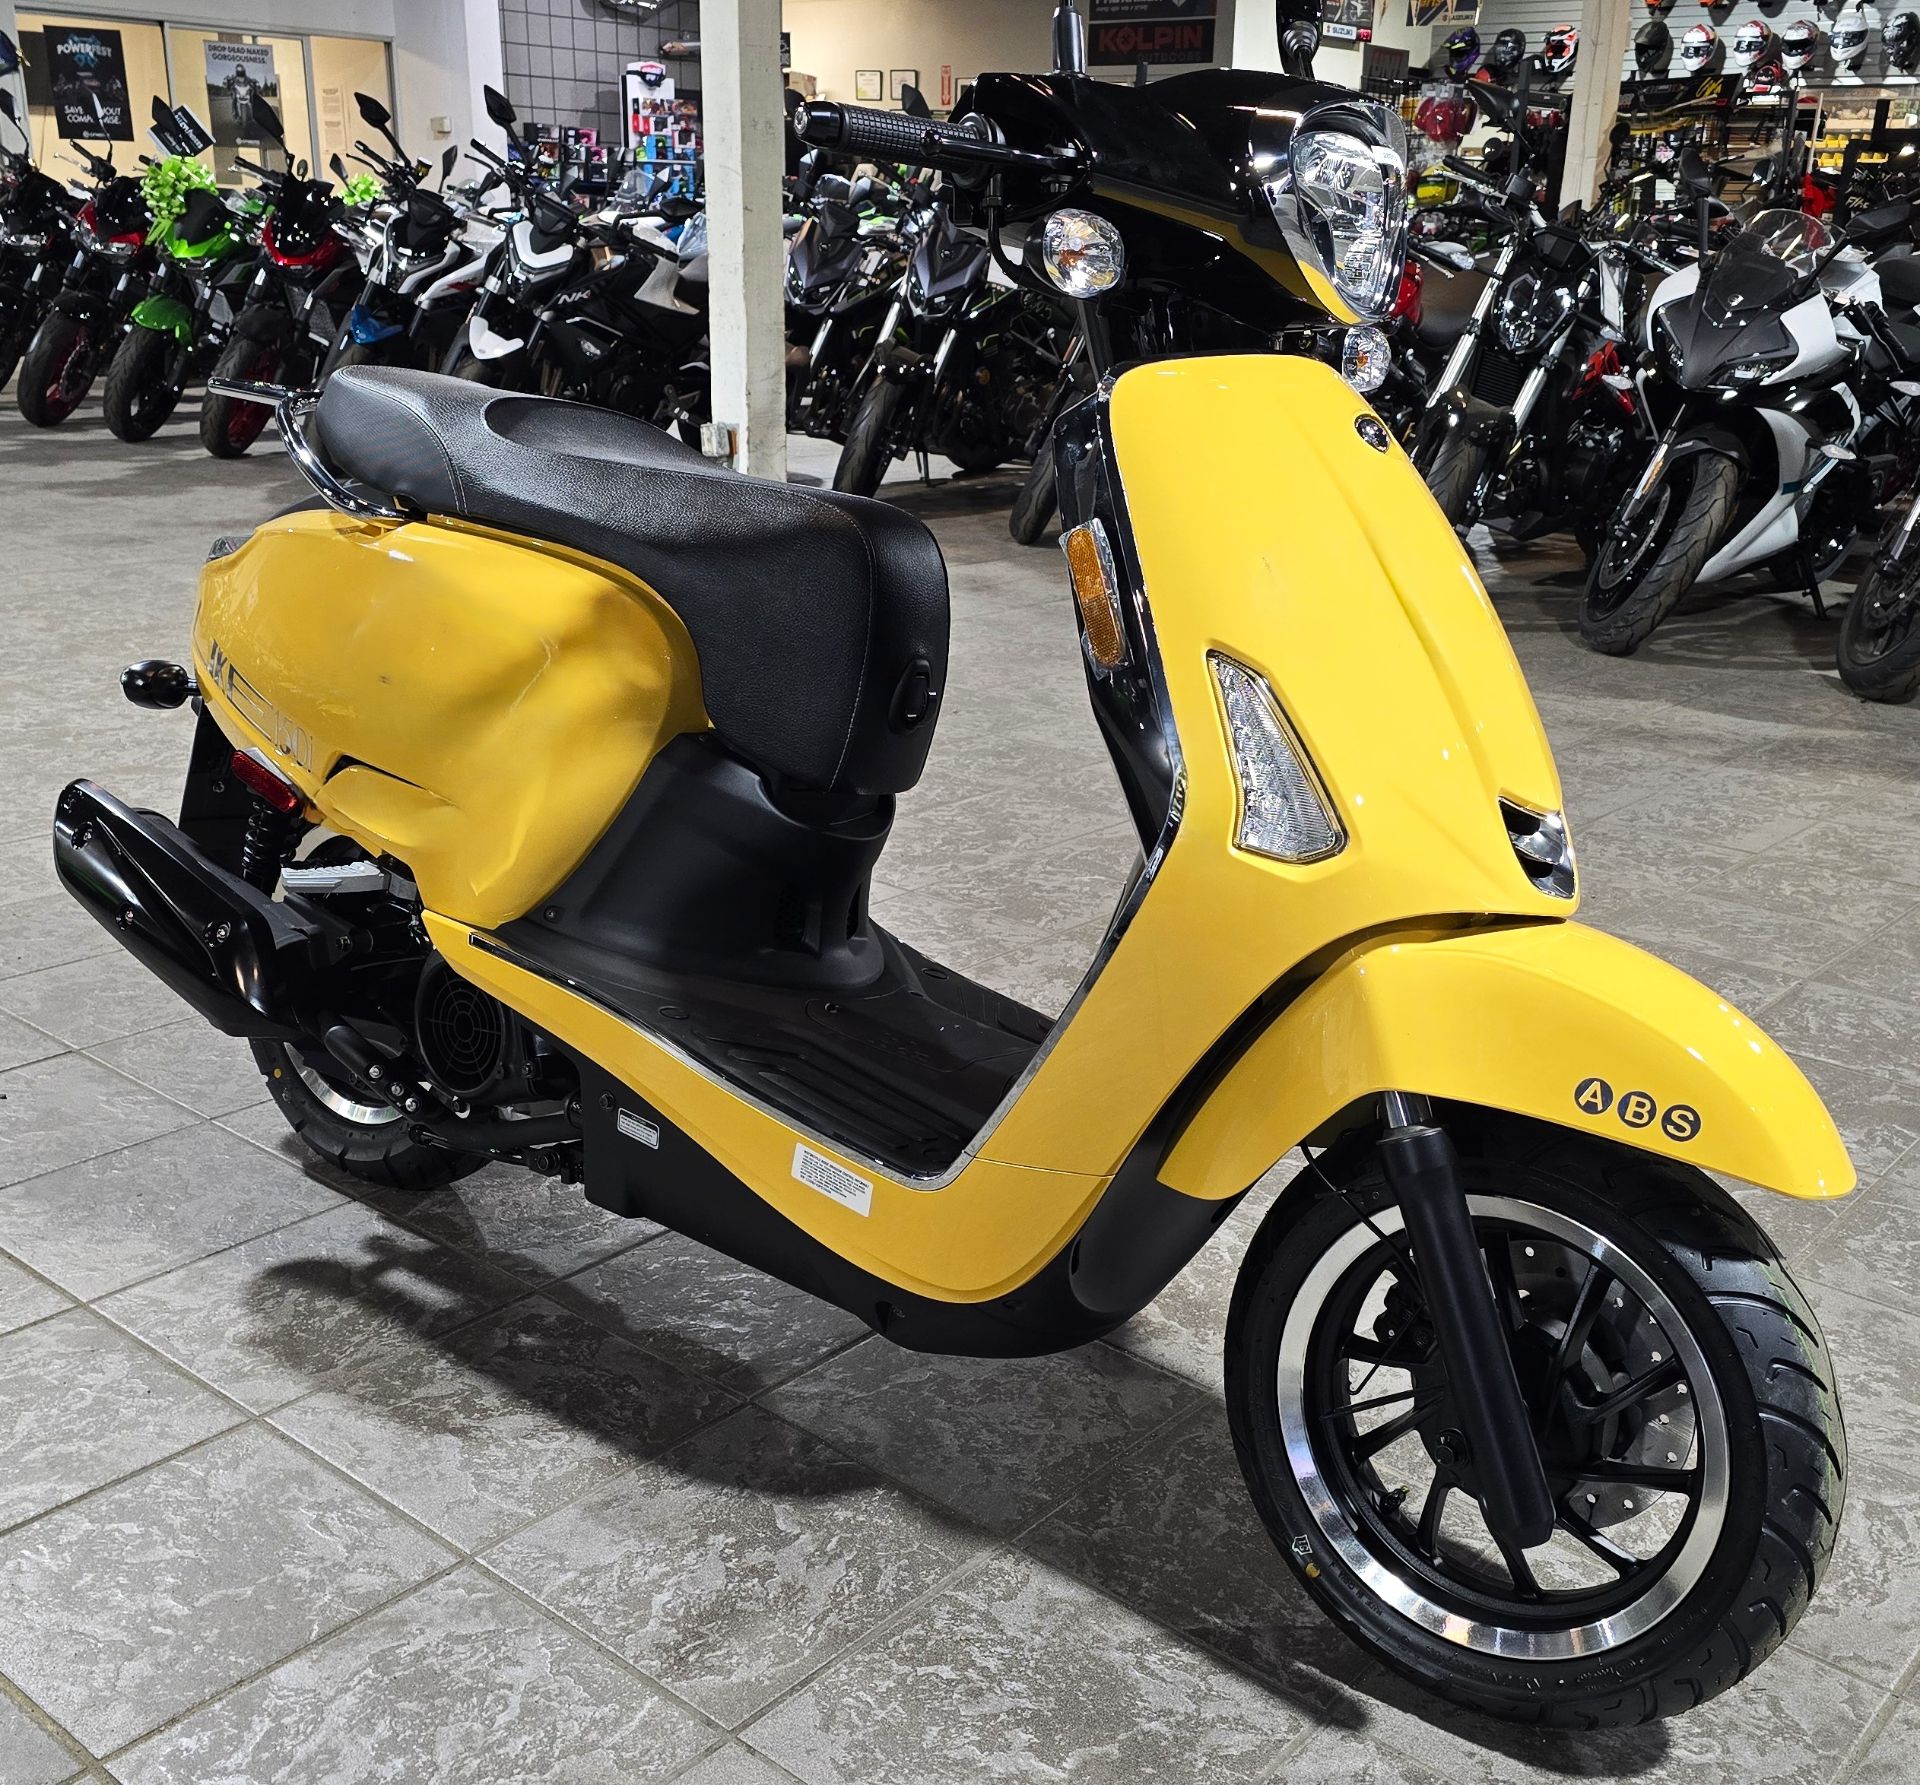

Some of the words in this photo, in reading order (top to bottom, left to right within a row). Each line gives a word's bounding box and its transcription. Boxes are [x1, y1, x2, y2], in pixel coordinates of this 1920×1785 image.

[1332, 26, 1353, 36] SUZUKI
[1099, 24, 1203, 54] KOLPIN
[56, 43, 112, 57] POWERFEST
[228, 46, 245, 54] DEAD
[246, 48, 269, 56] NAKED
[1576, 1079, 1697, 1139] ABS
